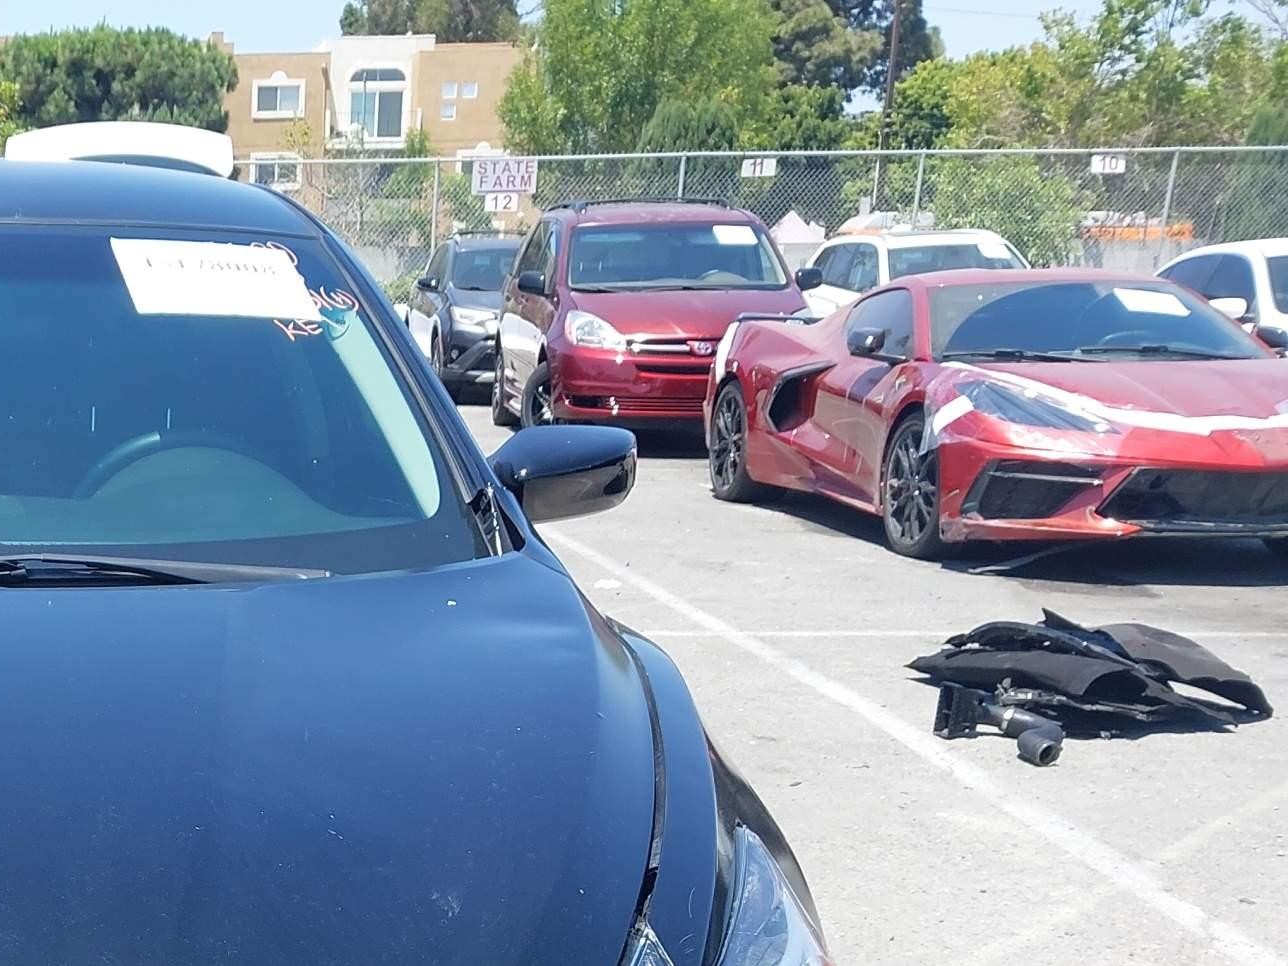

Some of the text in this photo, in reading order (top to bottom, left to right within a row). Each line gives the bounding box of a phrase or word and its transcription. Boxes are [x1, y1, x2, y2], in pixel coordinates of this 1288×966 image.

[478, 160, 534, 175] STATE
[750, 159, 764, 175] 11
[1100, 155, 1119, 171] 10
[479, 175, 531, 188] FARM
[491, 194, 512, 210] 12
